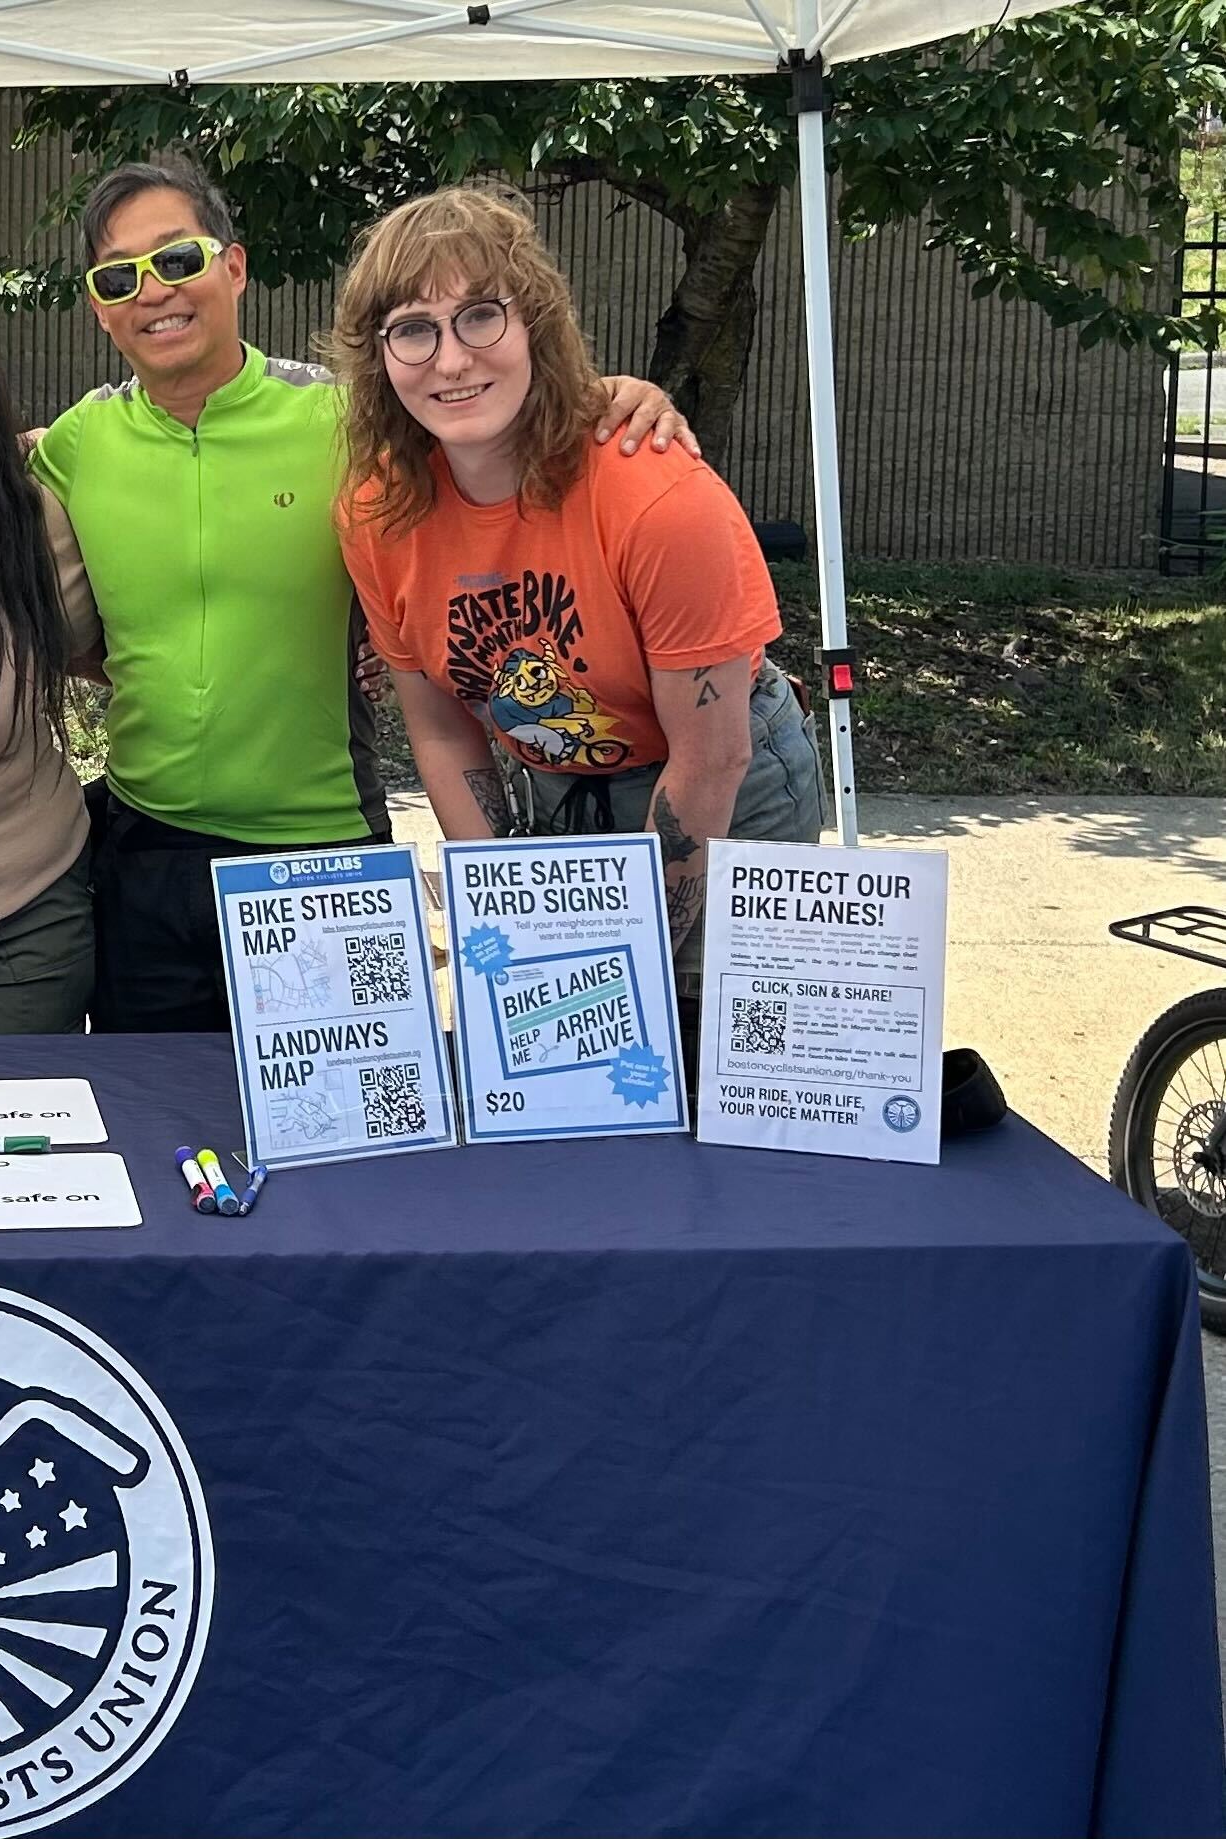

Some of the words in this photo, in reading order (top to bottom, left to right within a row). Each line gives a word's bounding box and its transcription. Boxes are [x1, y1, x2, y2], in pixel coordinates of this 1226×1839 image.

[448, 582, 522, 650] STATE
[523, 569, 584, 660] BIKE
[471, 618, 522, 669] MONTH
[289, 858, 322, 876] BCU
[324, 856, 363, 873] LABS
[464, 861, 524, 888] BIKE
[530, 856, 627, 886] SAFETY
[732, 866, 850, 895] PROTECT
[856, 873, 910, 899] OUR
[238, 897, 295, 927] BIKE
[300, 888, 392, 921] STRESS
[466, 890, 536, 917] YARD
[543, 885, 629, 914] SIGNS!
[731, 895, 787, 921] BIKE
[795, 898, 885, 927] LANES!
[514, 920, 531, 930] Tell
[533, 920, 554, 932] your
[555, 918, 604, 930] neighbors
[605, 917, 624, 926] that
[626, 917, 644, 928] you
[539, 932, 563, 941] want
[564, 931, 584, 940] safe
[242, 926, 297, 957] MAP
[503, 982, 552, 1019] BIKE
[555, 957, 624, 1000] LANES
[752, 980, 793, 998] CLICK,
[796, 982, 828, 999] SIGN
[831, 985, 841, 998] &
[844, 986, 892, 1002] SHARE!
[555, 994, 631, 1043] ARRIVE
[255, 1021, 389, 1061] LANDWAYS
[509, 1028, 541, 1051] HELP
[576, 1018, 635, 1061] ALIVE
[512, 1047, 533, 1066] ME
[727, 1058, 912, 1084] bostoncyclistsunion.org/thank-you
[259, 1059, 315, 1091] MAP
[486, 1090, 525, 1116] $20
[719, 1101, 755, 1116] YOUR
[758, 1104, 797, 1120] VOICE
[800, 1108, 859, 1126] MATTER!
[720, 1085, 755, 1100] YOUR
[758, 1086, 792, 1105] RIDE,
[795, 1090, 832, 1107] YOUR
[835, 1094, 866, 1112] LIFE,
[39, 1111, 71, 1119] on
[1, 1193, 58, 1203] safe
[65, 1194, 100, 1202] on
[74, 1578, 178, 1753] UNION
